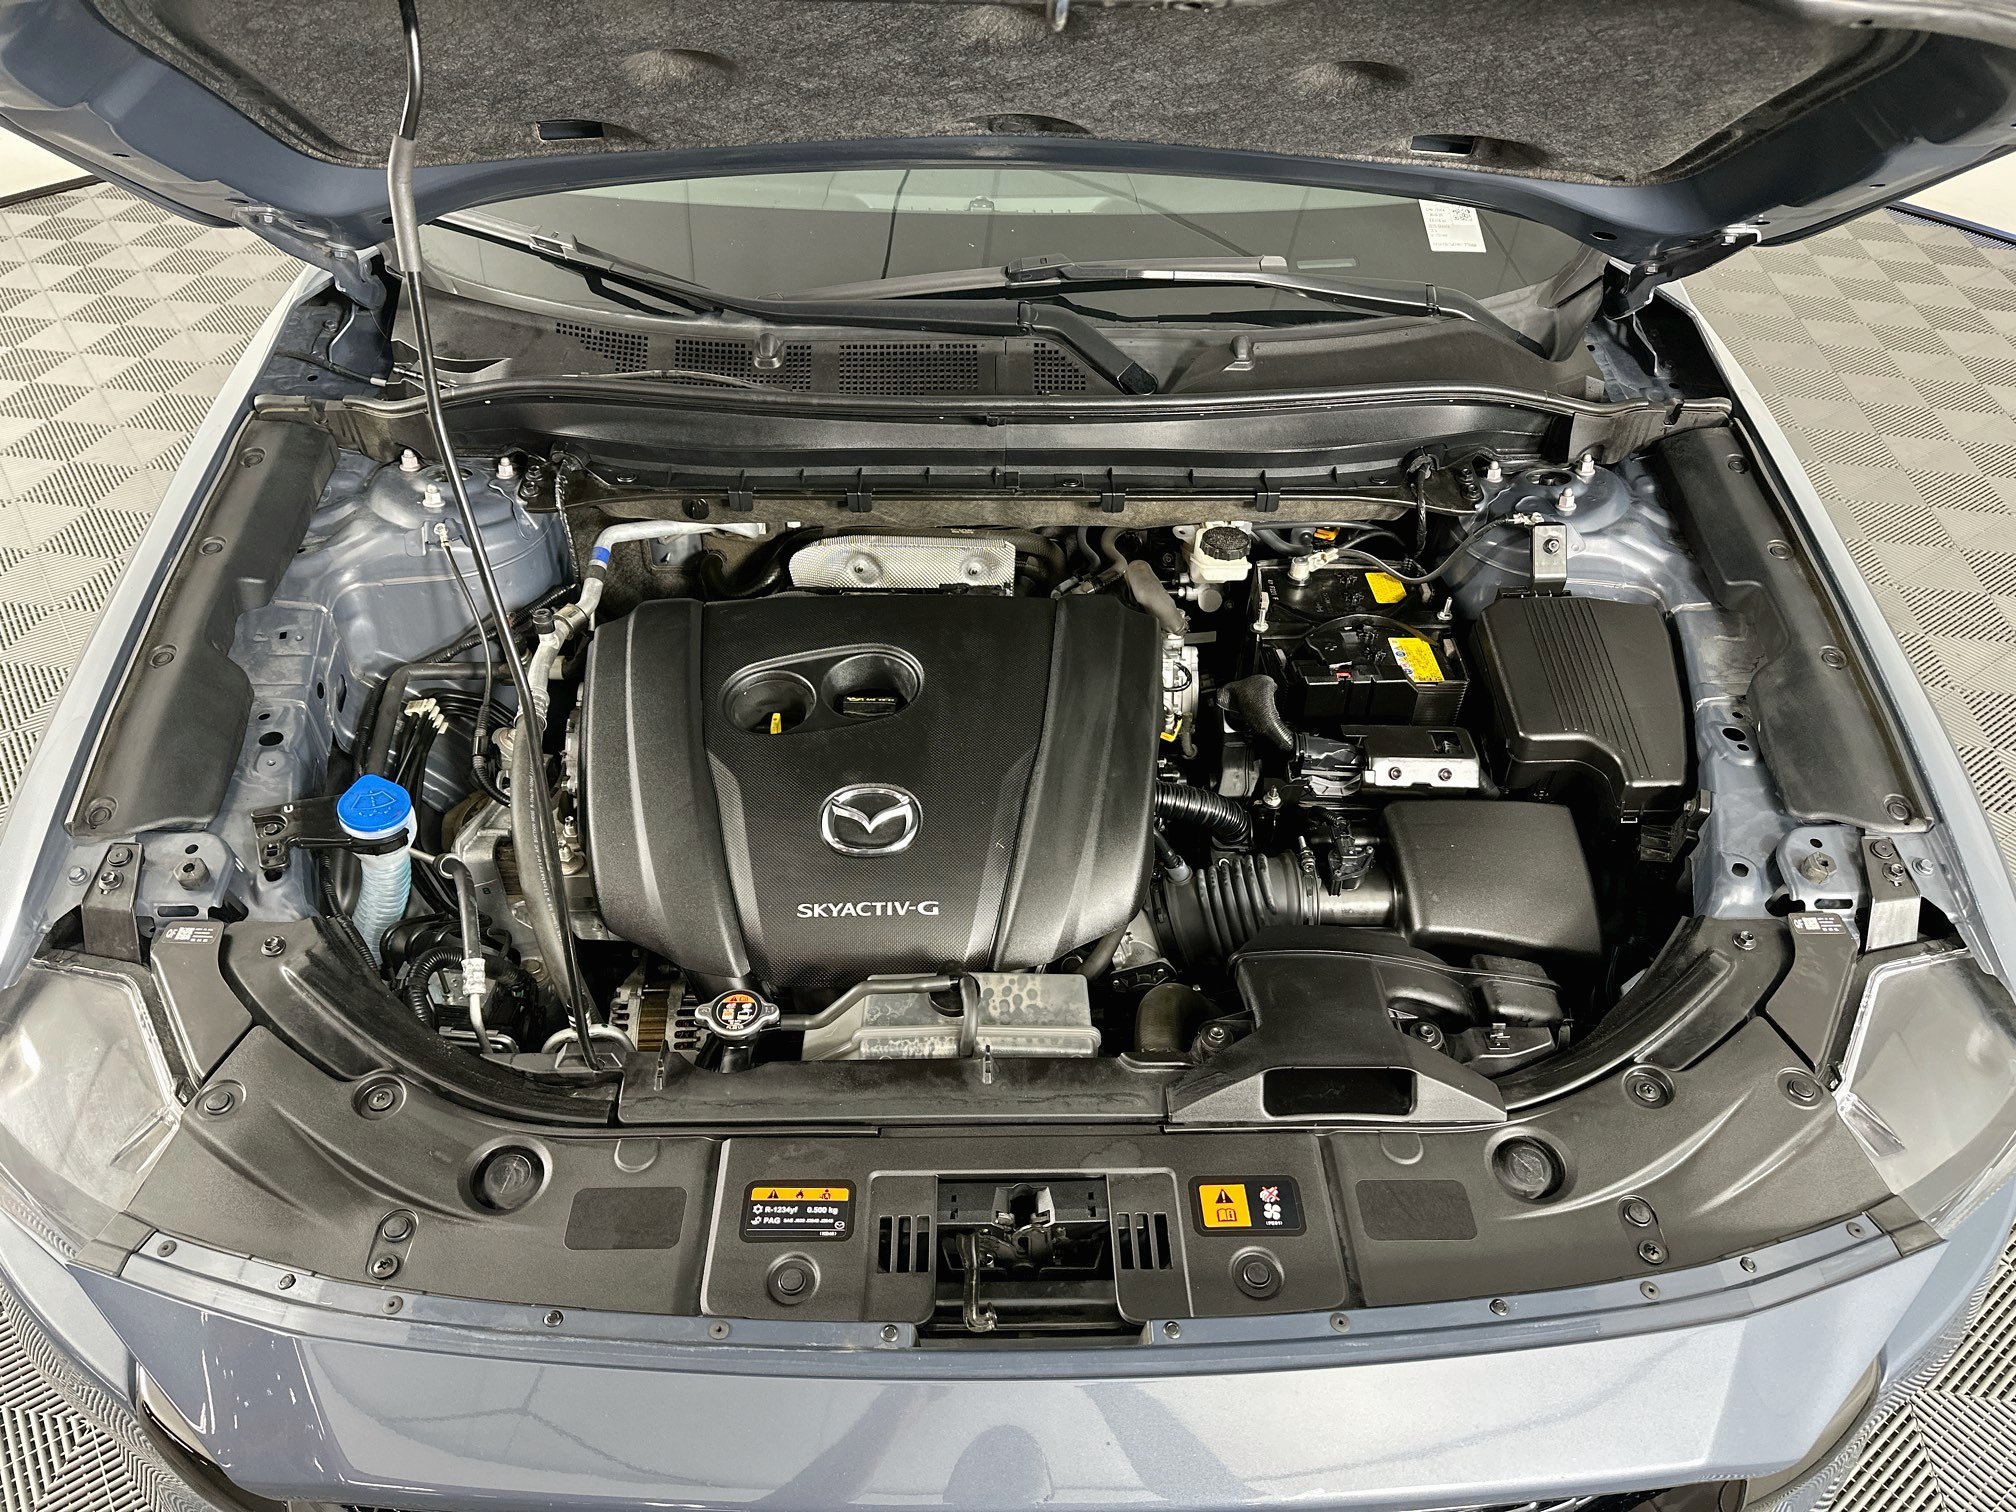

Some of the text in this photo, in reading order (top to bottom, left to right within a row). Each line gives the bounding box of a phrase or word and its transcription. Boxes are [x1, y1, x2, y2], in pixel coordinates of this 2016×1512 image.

[531, 823, 539, 843] SUCTION
[797, 901, 939, 917] SKYACTIV-G
[764, 1206, 799, 1215] R-1234yf
[828, 1206, 839, 1215] kg
